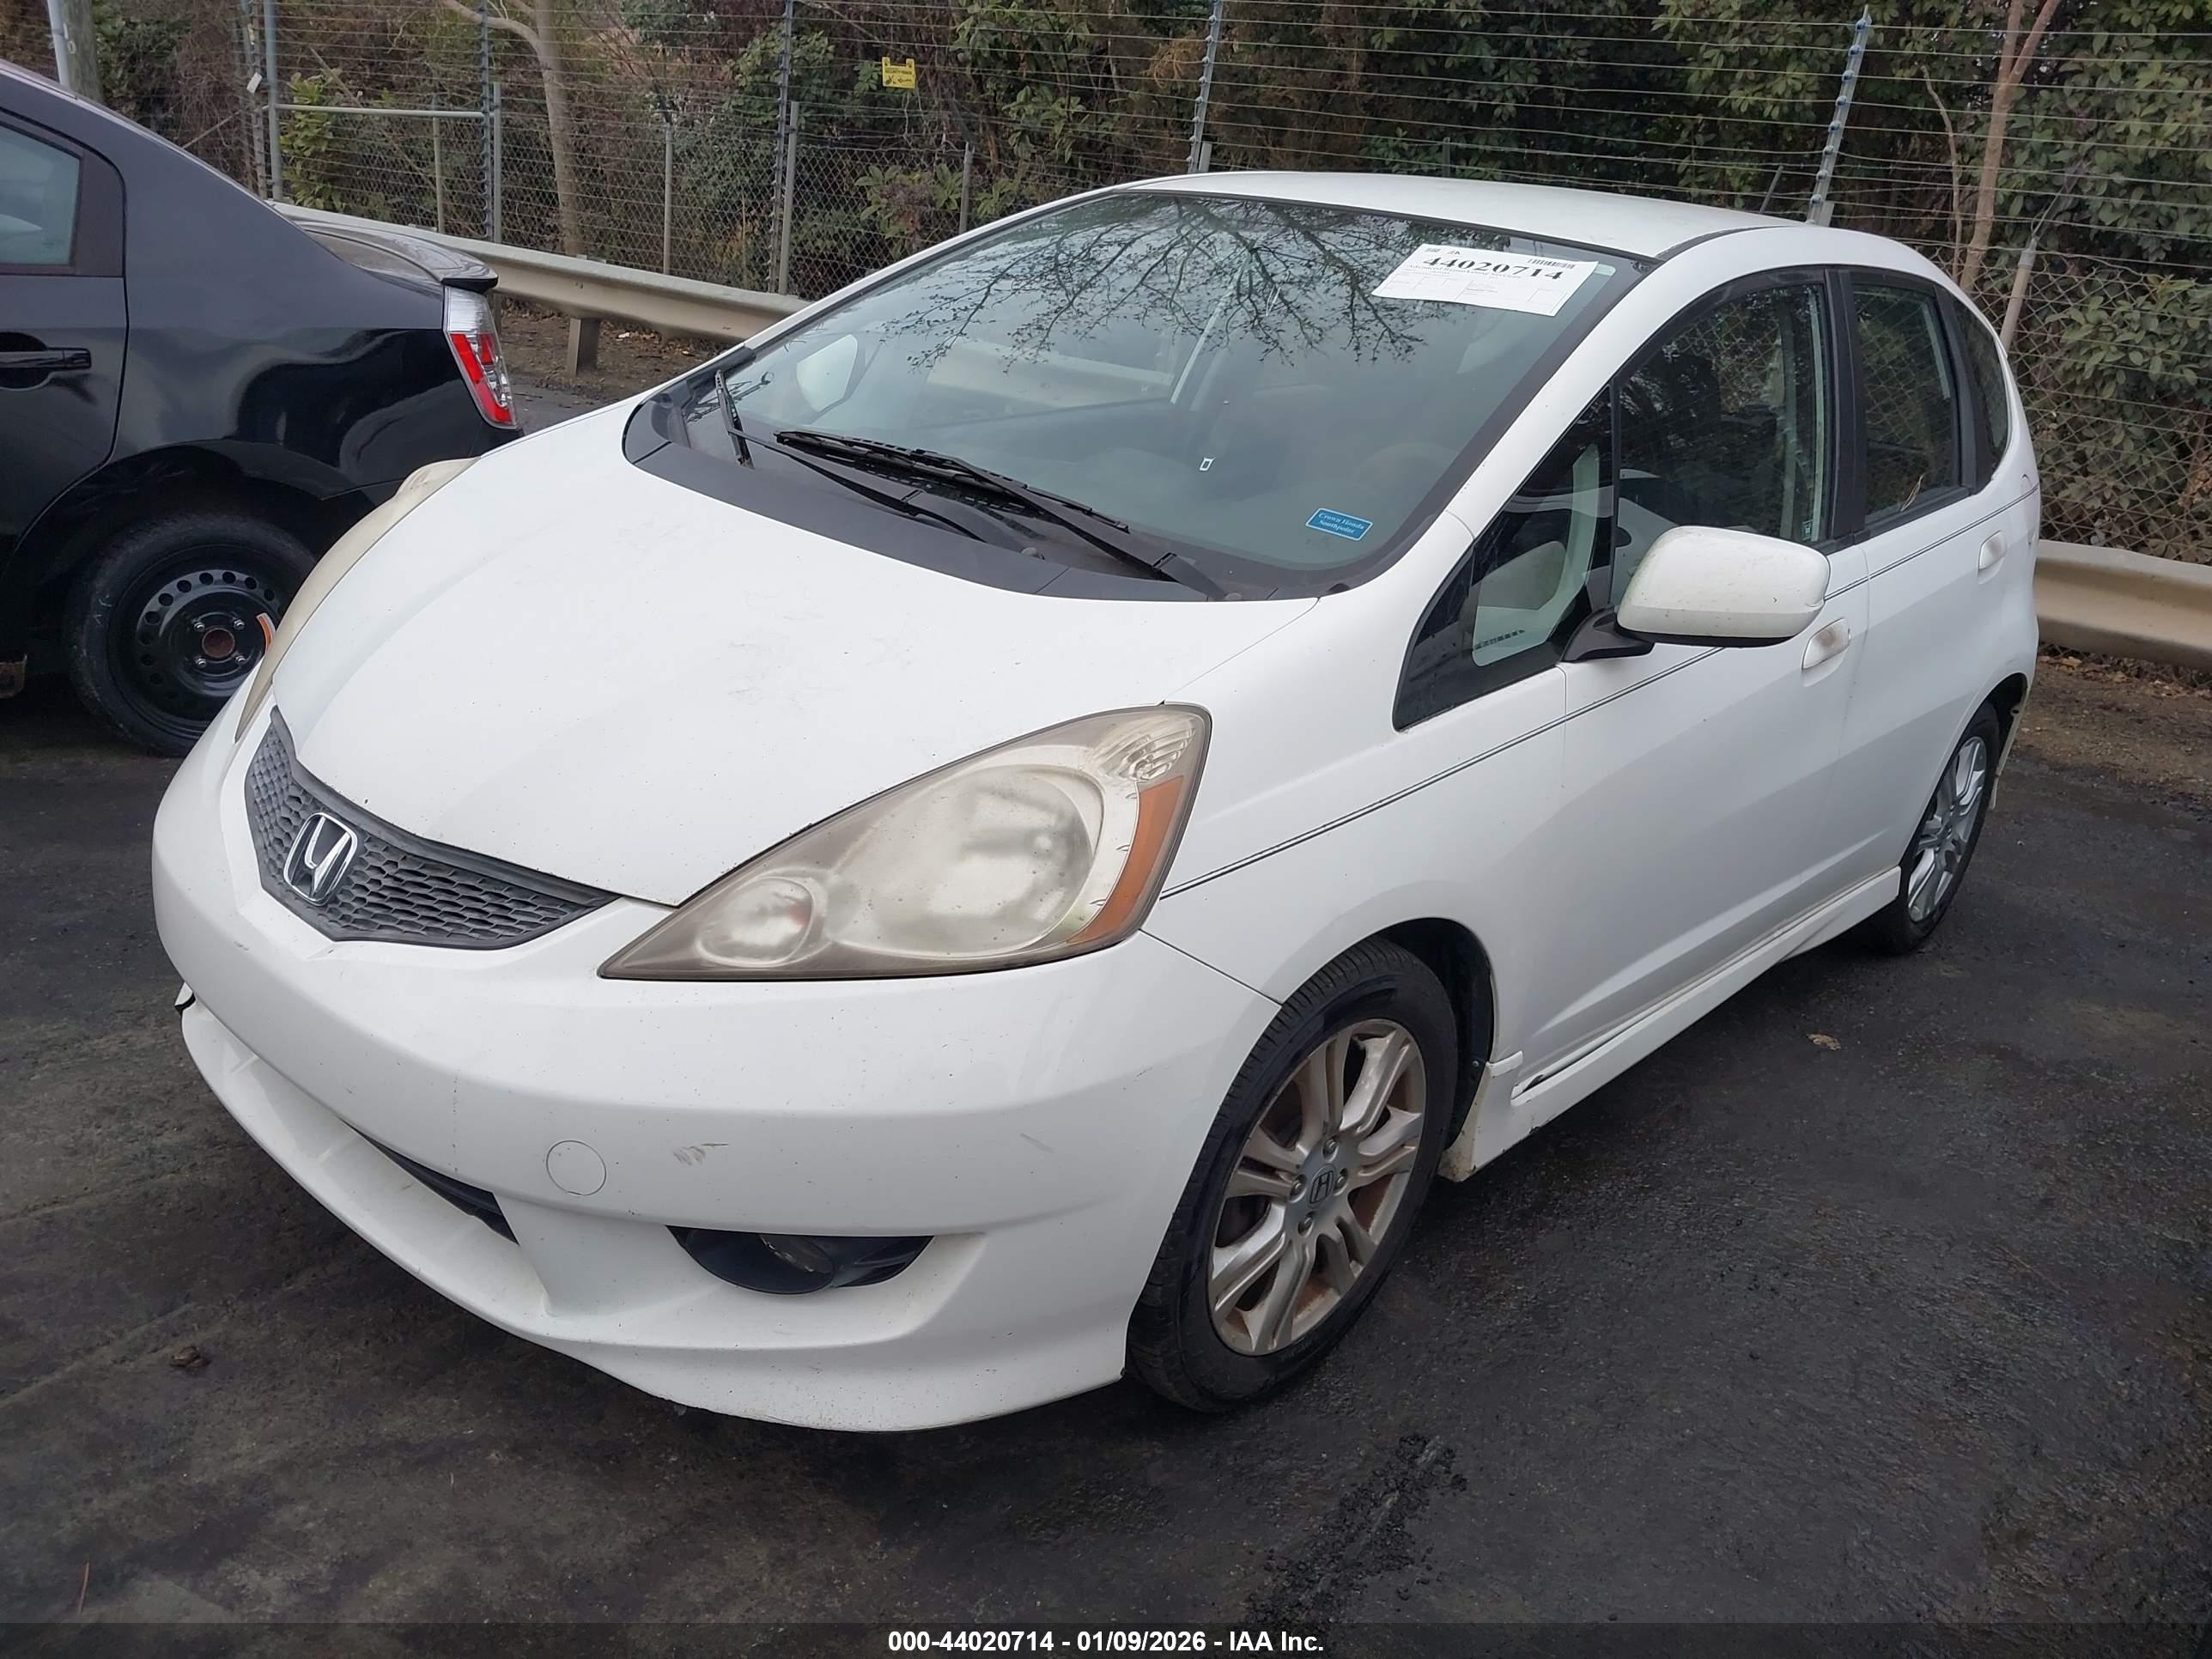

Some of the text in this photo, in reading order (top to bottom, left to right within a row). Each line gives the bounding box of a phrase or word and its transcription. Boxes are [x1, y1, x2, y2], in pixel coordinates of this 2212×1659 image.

[1423, 257, 1563, 280] 44020714
[1318, 513, 1364, 530] Crown Honda
[1319, 520, 1355, 533] Southpoint
